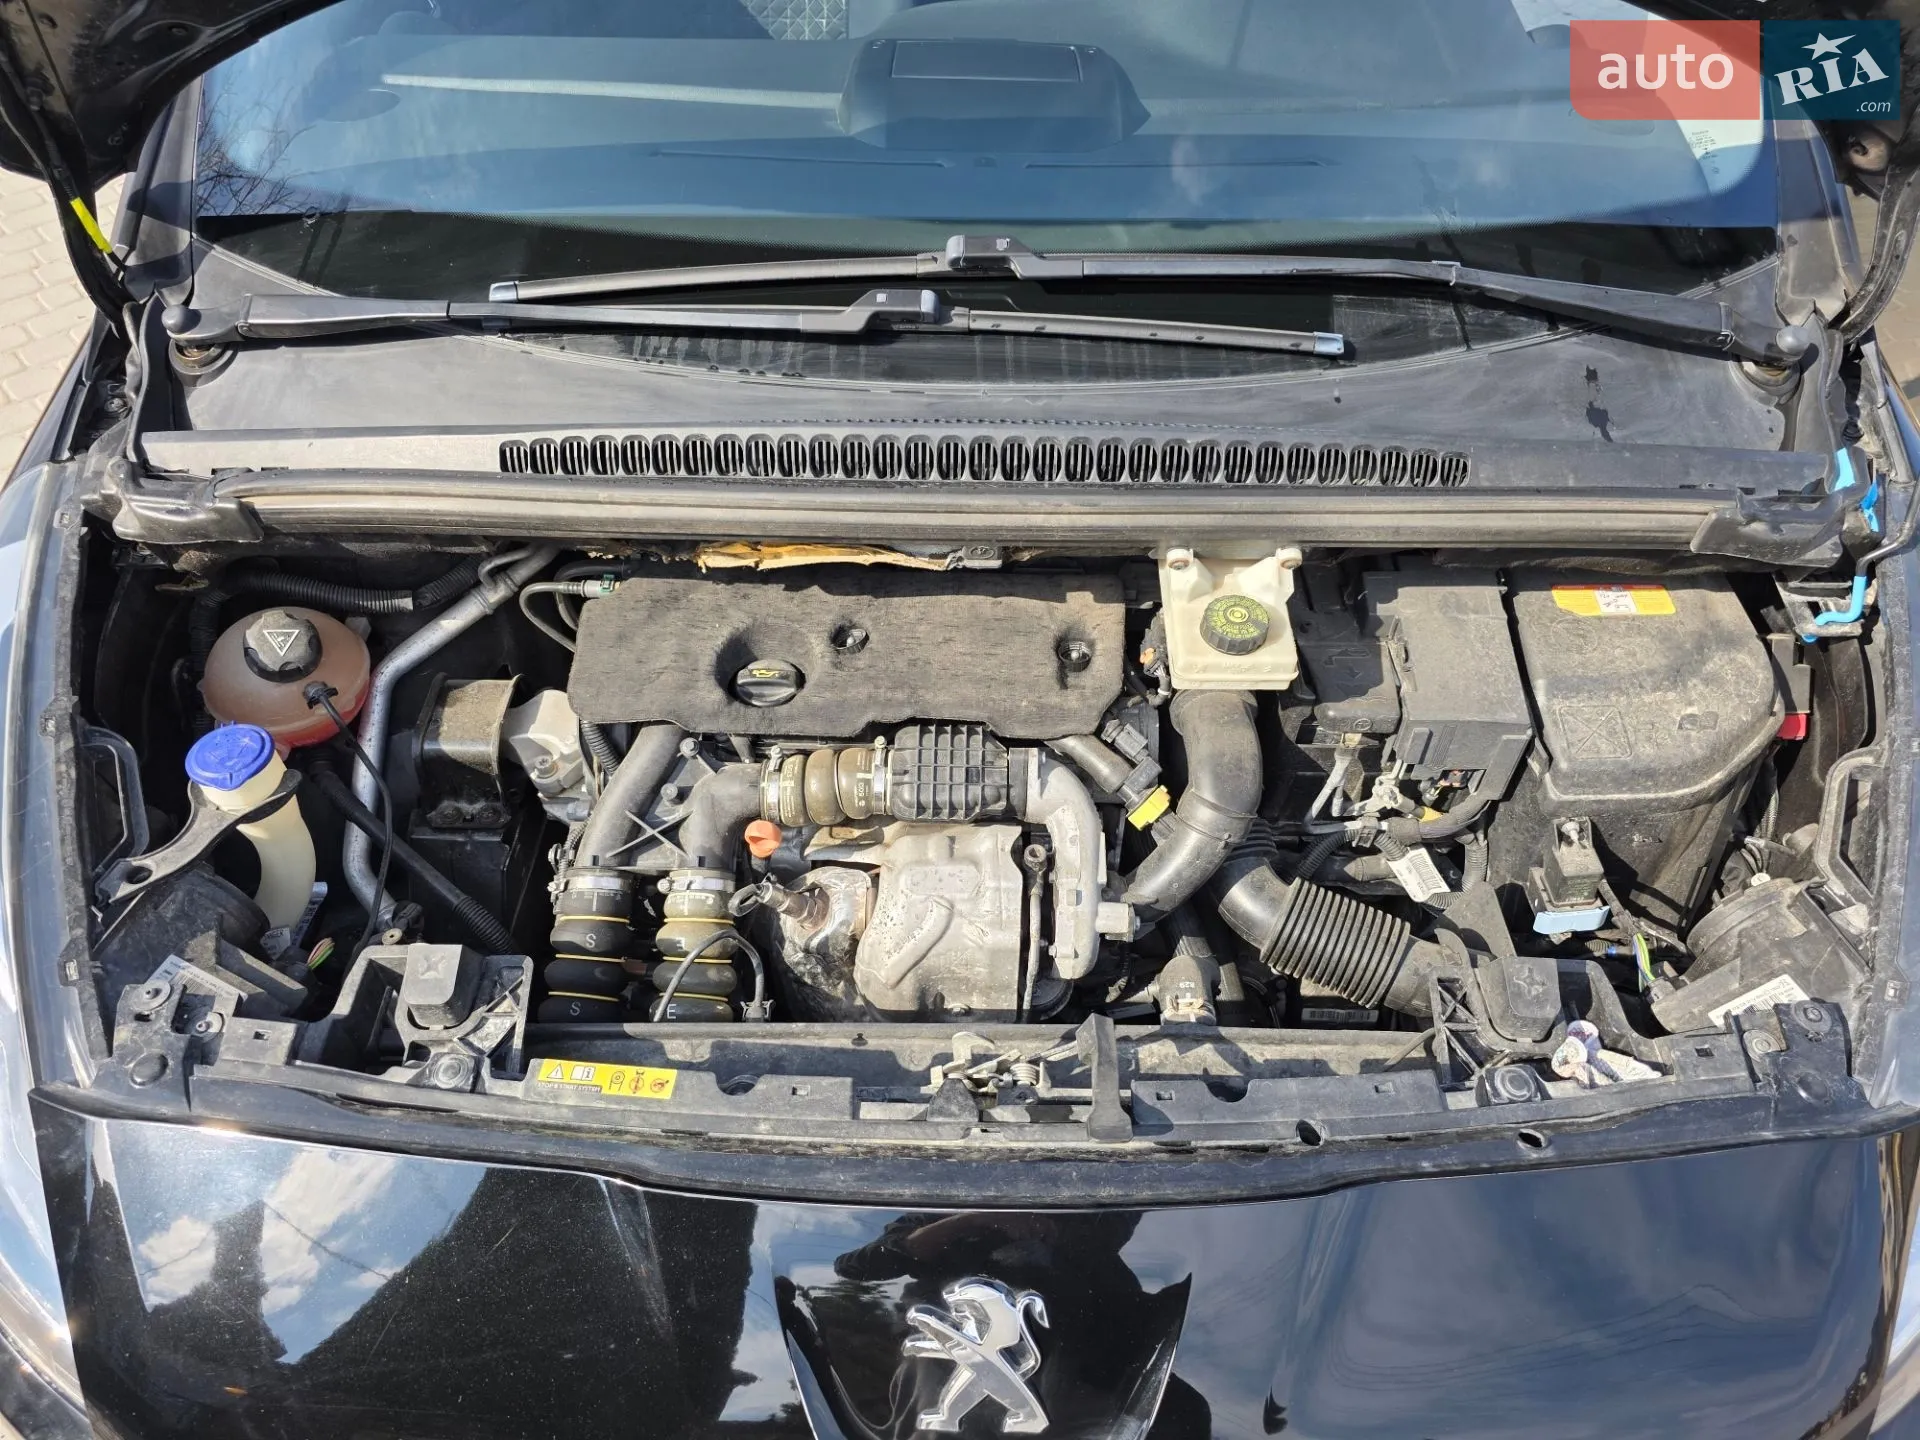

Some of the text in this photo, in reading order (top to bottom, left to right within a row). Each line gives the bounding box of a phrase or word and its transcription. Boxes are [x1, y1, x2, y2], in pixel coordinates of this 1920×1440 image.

[586, 934, 596, 948] S
[570, 1001, 580, 1015] S
[667, 1004, 676, 1018] E
